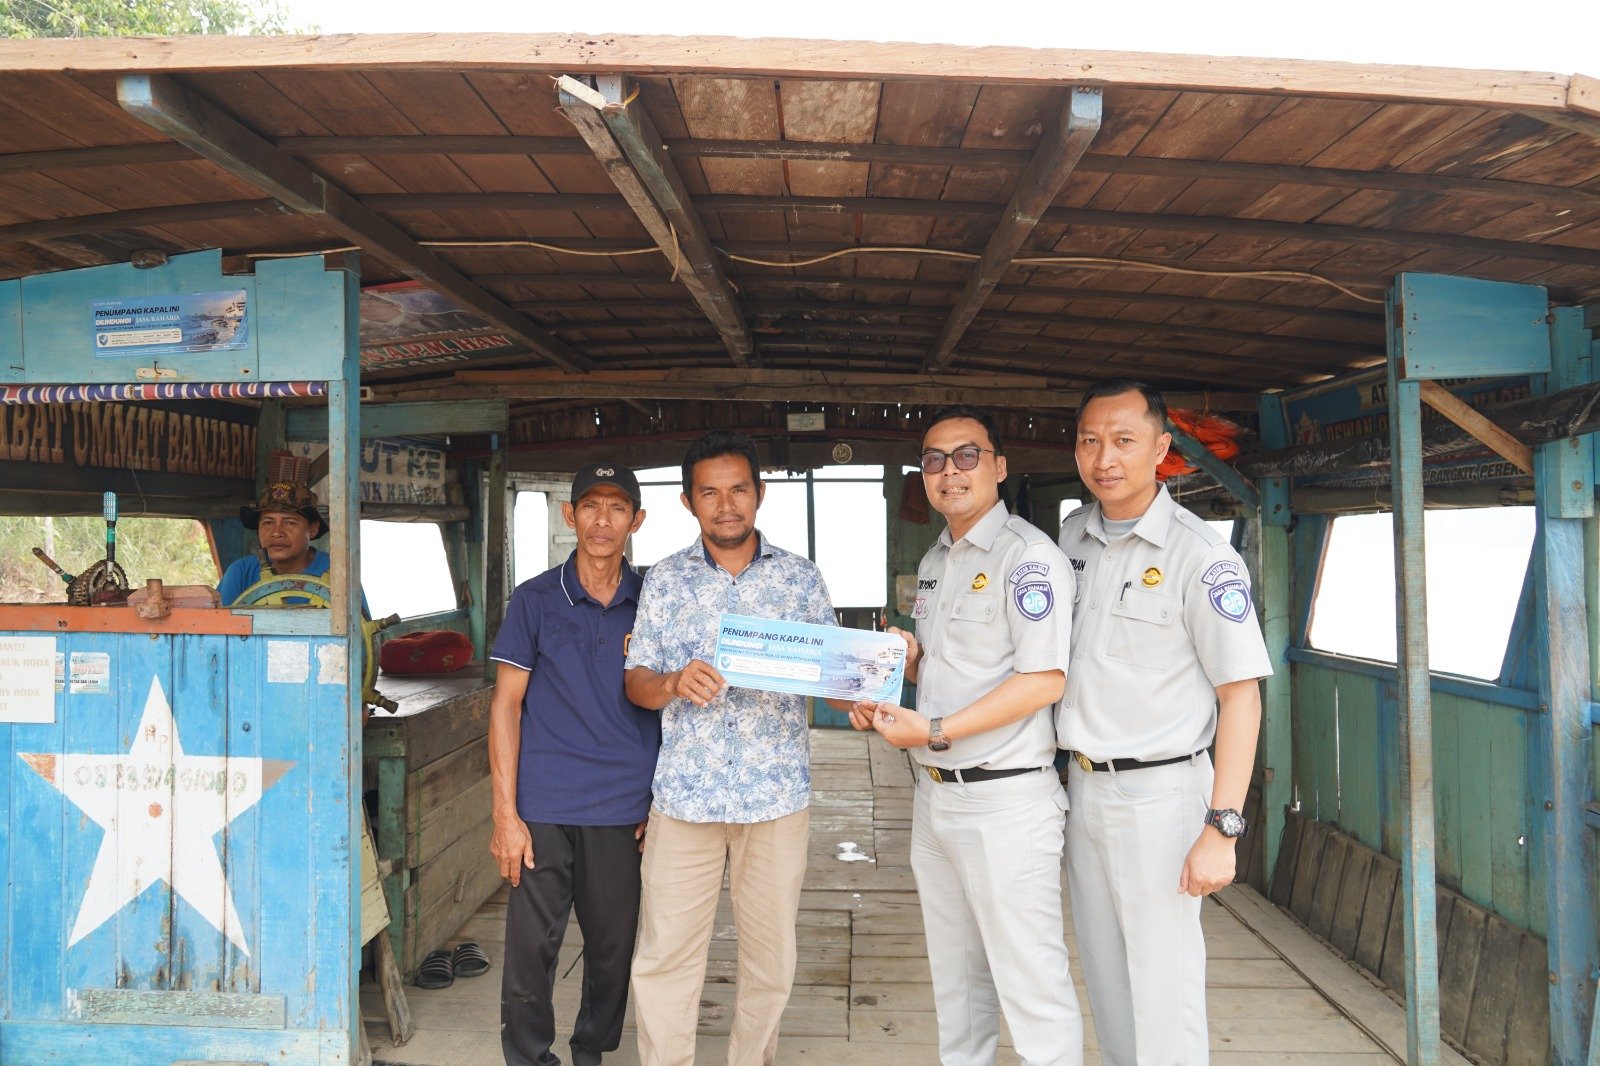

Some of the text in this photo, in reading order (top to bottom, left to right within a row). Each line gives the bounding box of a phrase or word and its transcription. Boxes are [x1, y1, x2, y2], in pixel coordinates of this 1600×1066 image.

[95, 305, 180, 317] PENUMPANG KAPAL INI
[95, 317, 132, 326] DILINDUNGI
[71, 401, 165, 471] UMMAT
[1479, 461, 1528, 480] PEREK
[720, 637, 764, 650] DILINDUNGI
[722, 627, 824, 647] PENUMPANG KAPAL INI
